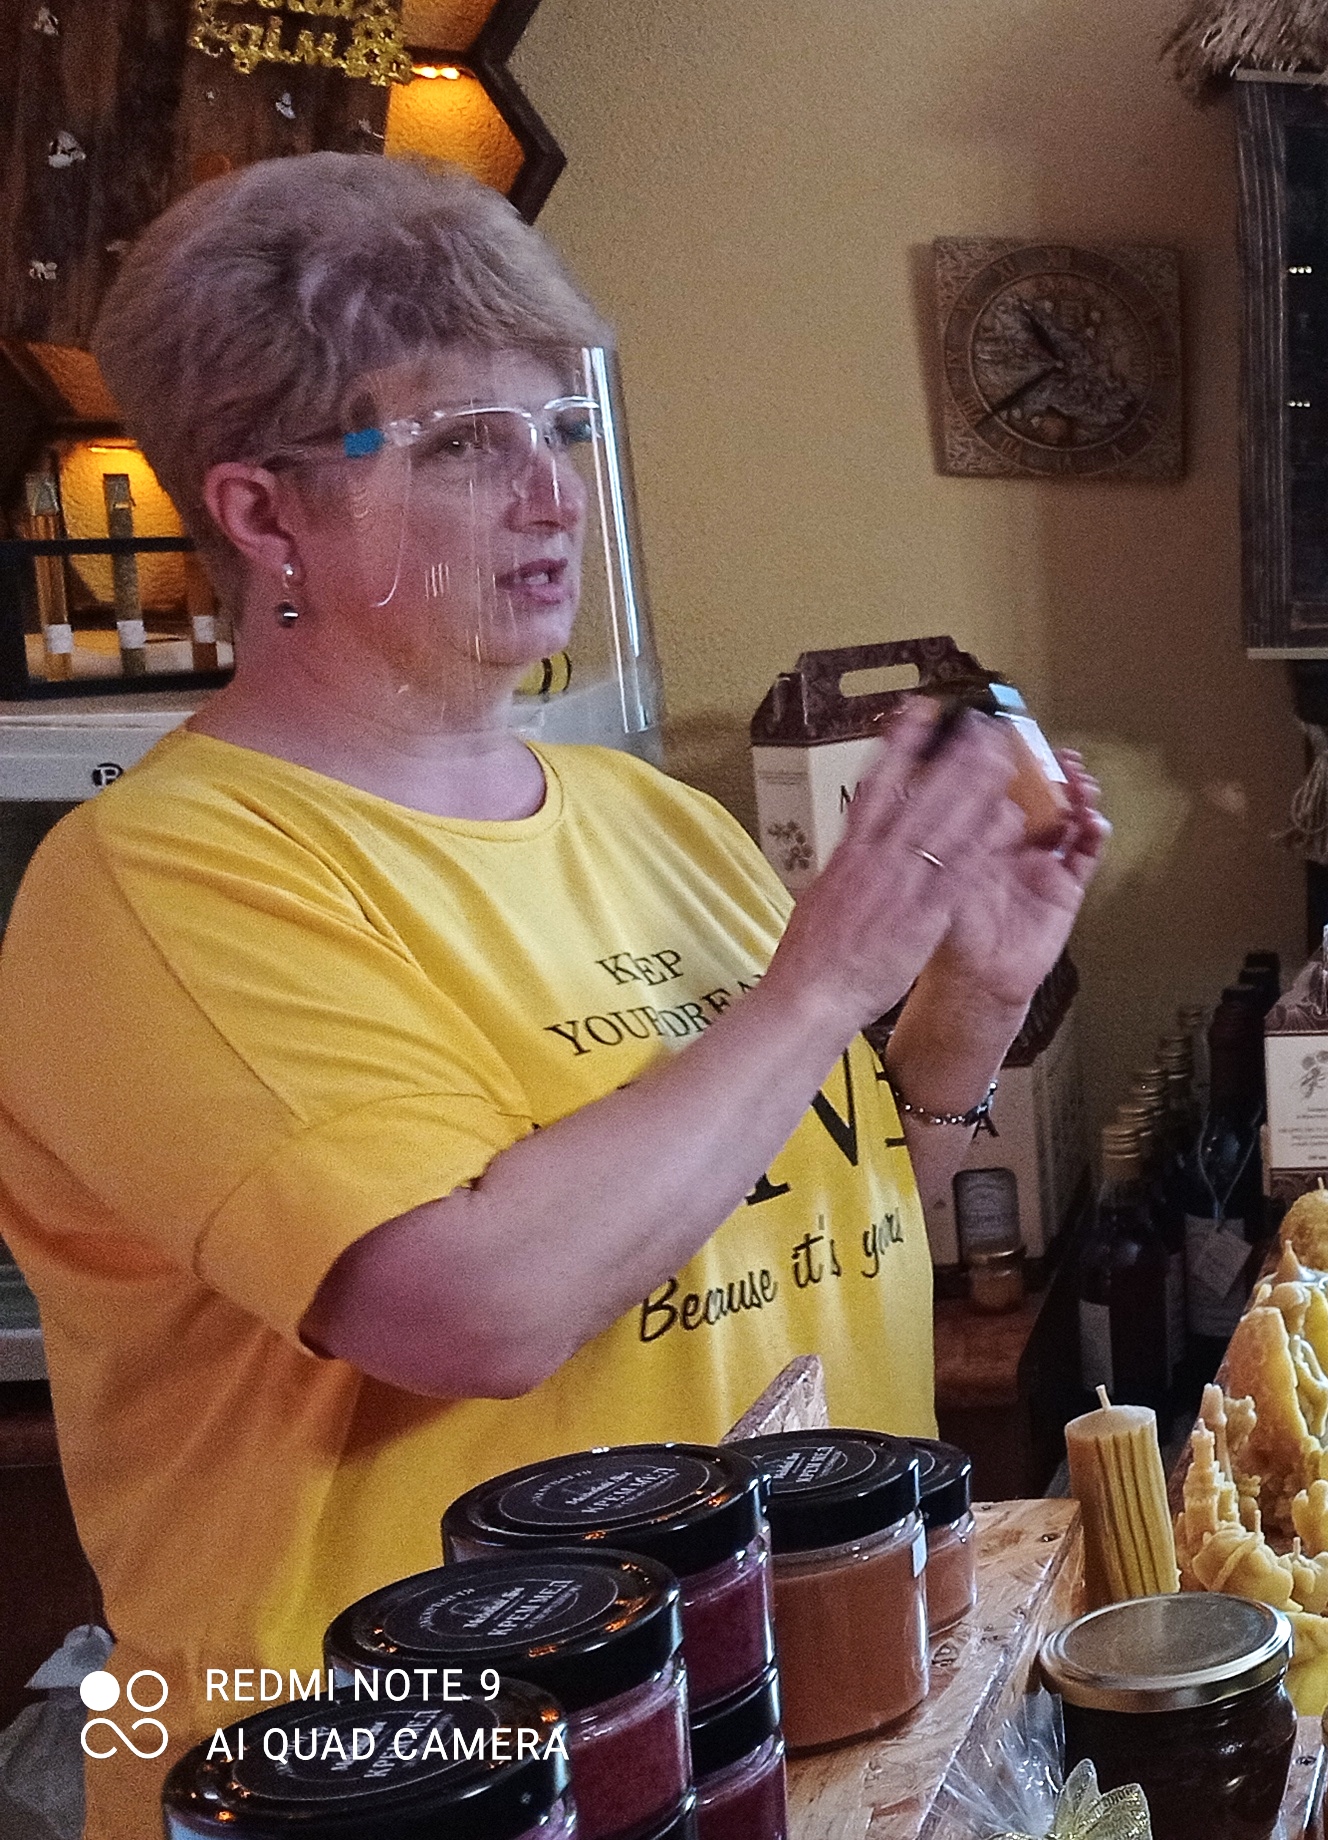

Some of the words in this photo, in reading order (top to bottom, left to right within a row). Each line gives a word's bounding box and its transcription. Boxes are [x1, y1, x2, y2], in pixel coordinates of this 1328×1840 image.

[641, 1267, 777, 1342] Because
[792, 1215, 841, 1288] it's
[581, 1487, 637, 1513] КРЕМ
[630, 1467, 676, 1487] МЕД
[487, 1600, 538, 1636] КРЕМ
[533, 1580, 574, 1603] МЕД
